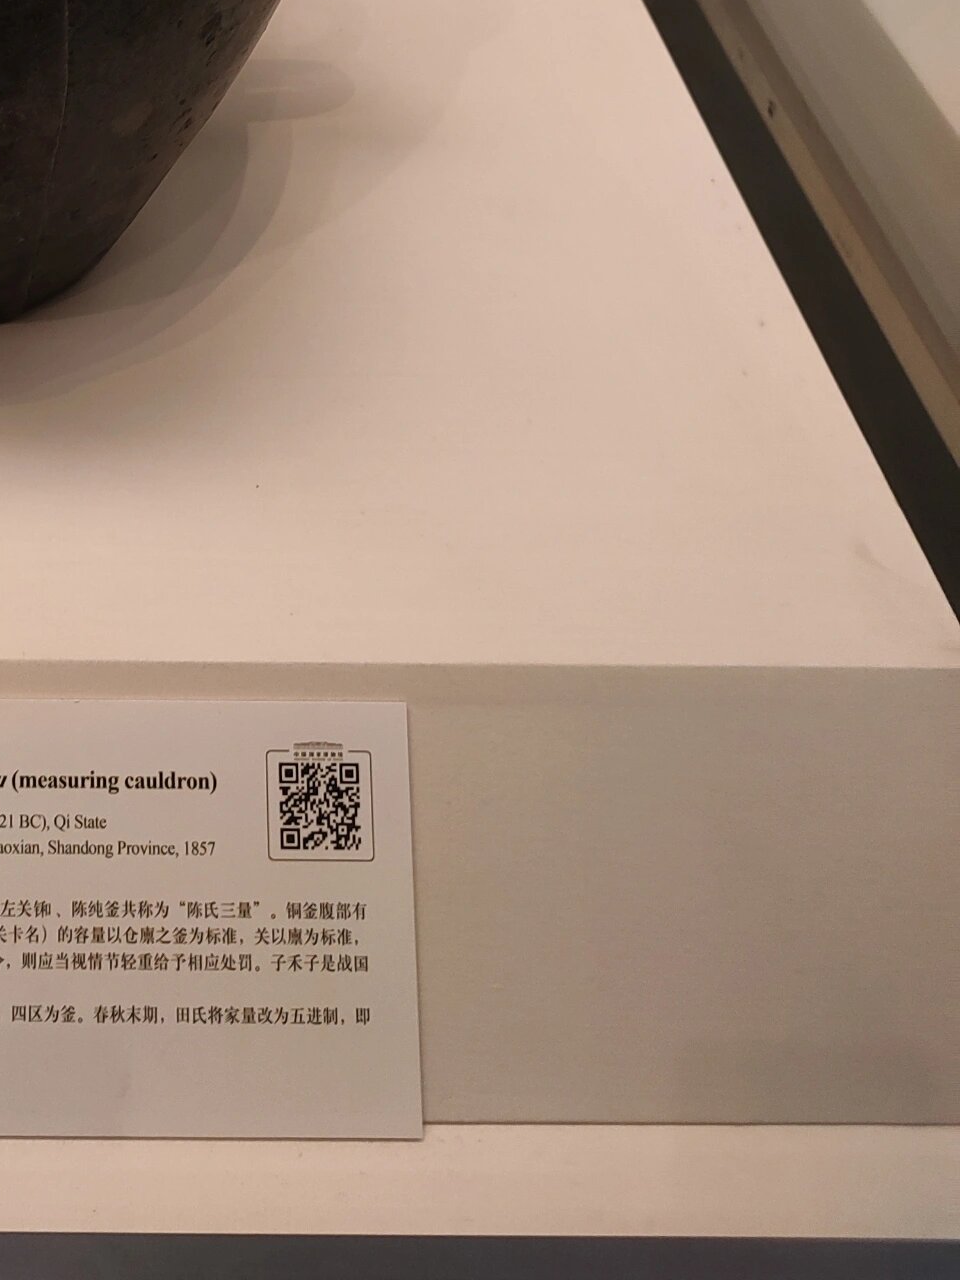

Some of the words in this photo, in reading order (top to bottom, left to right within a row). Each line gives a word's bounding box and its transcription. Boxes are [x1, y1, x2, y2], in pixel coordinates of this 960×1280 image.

[11, 769, 120, 795] (measuring
[124, 770, 218, 796] cauldron)
[18, 813, 51, 833] BC),
[53, 813, 71, 832] Qi
[74, 814, 108, 830] State
[47, 839, 114, 859] Shandong
[117, 839, 180, 859] Province,
[184, 840, 216, 857] 1857
